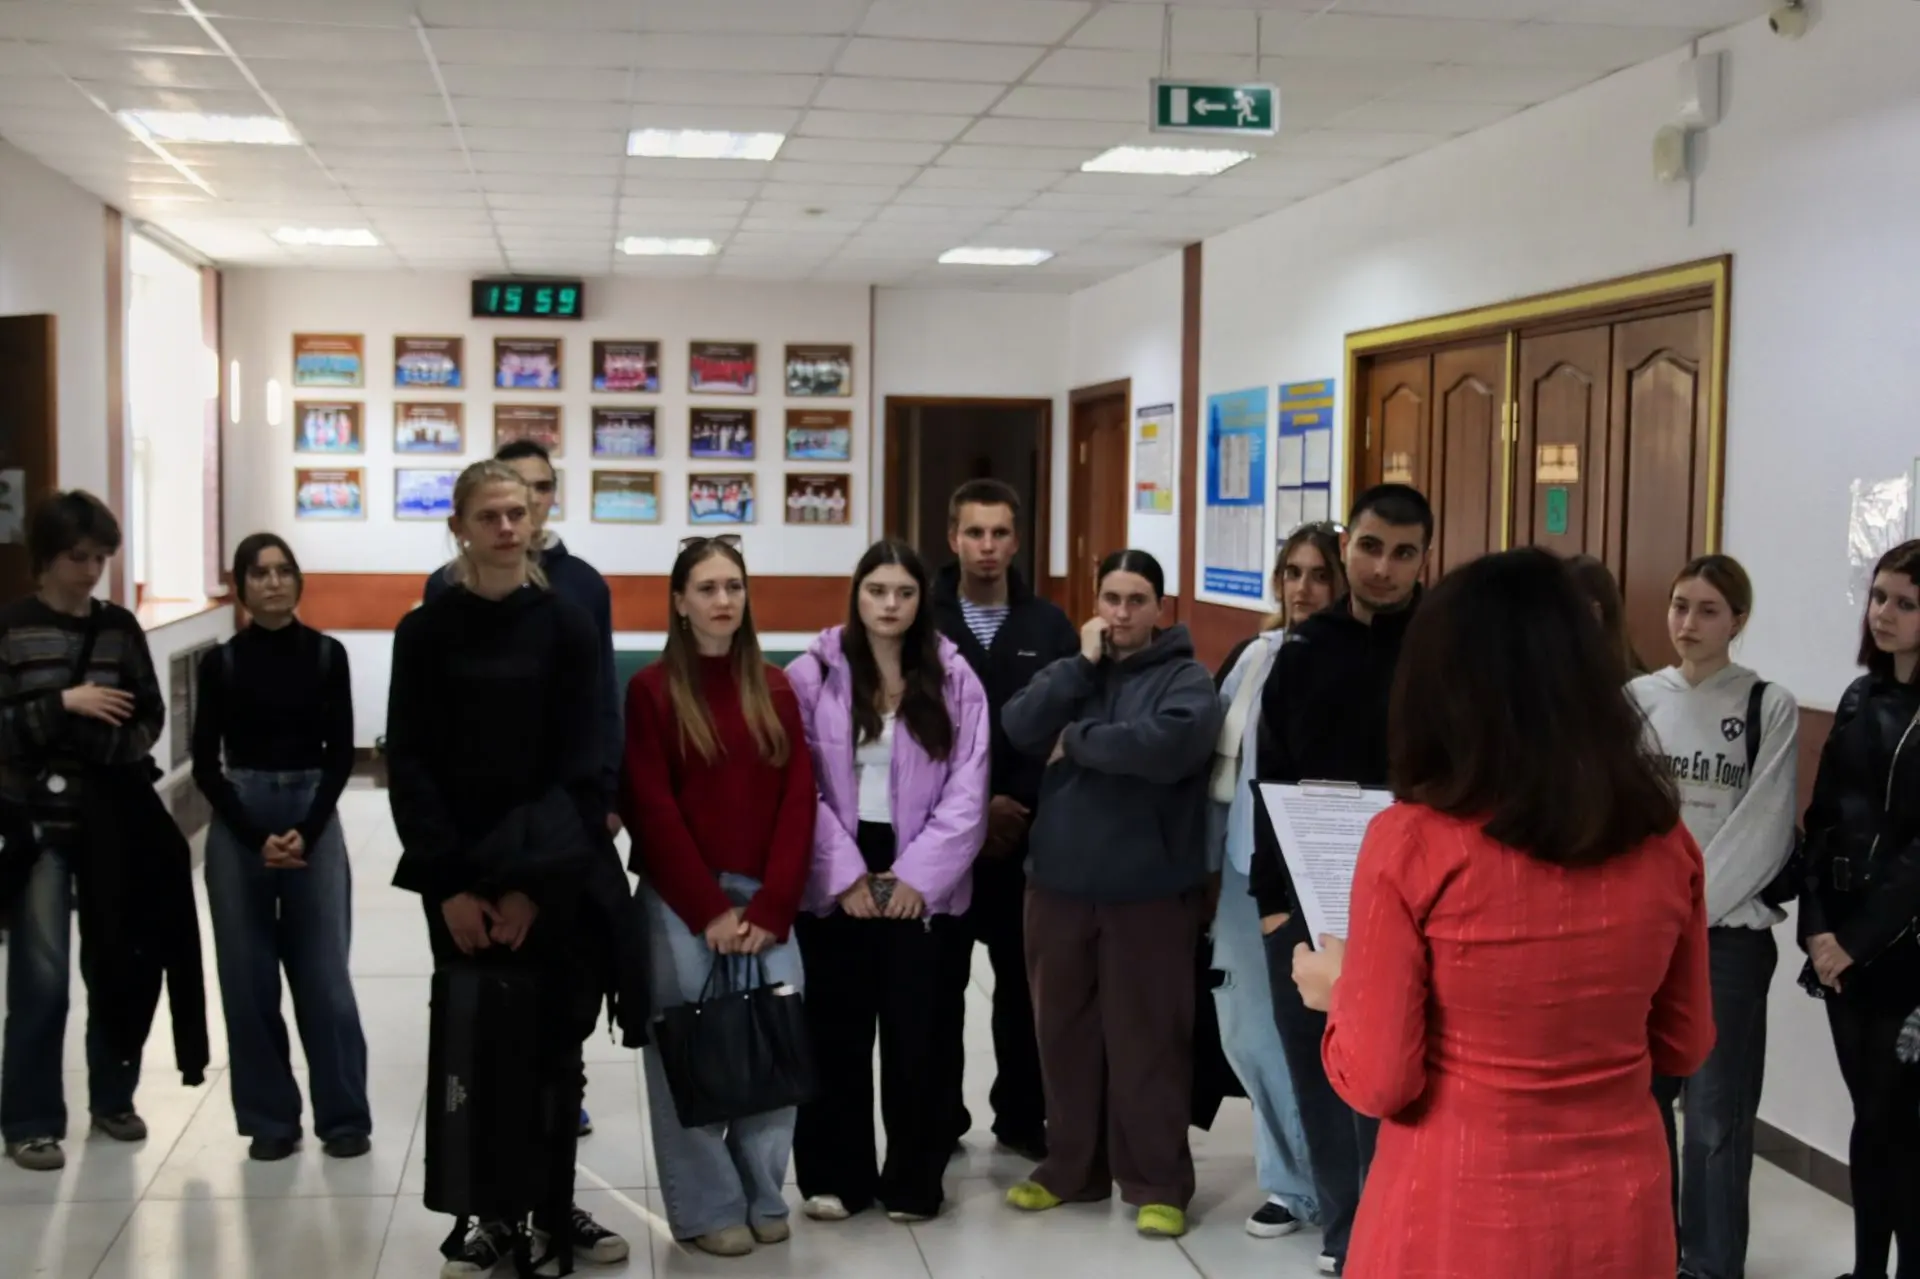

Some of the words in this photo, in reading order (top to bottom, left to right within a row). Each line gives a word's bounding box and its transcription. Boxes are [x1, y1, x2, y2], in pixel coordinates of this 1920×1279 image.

[489, 285, 523, 312] 15
[534, 286, 576, 313] 59
[1692, 751, 1710, 781] En
[1715, 753, 1746, 789] Tout
